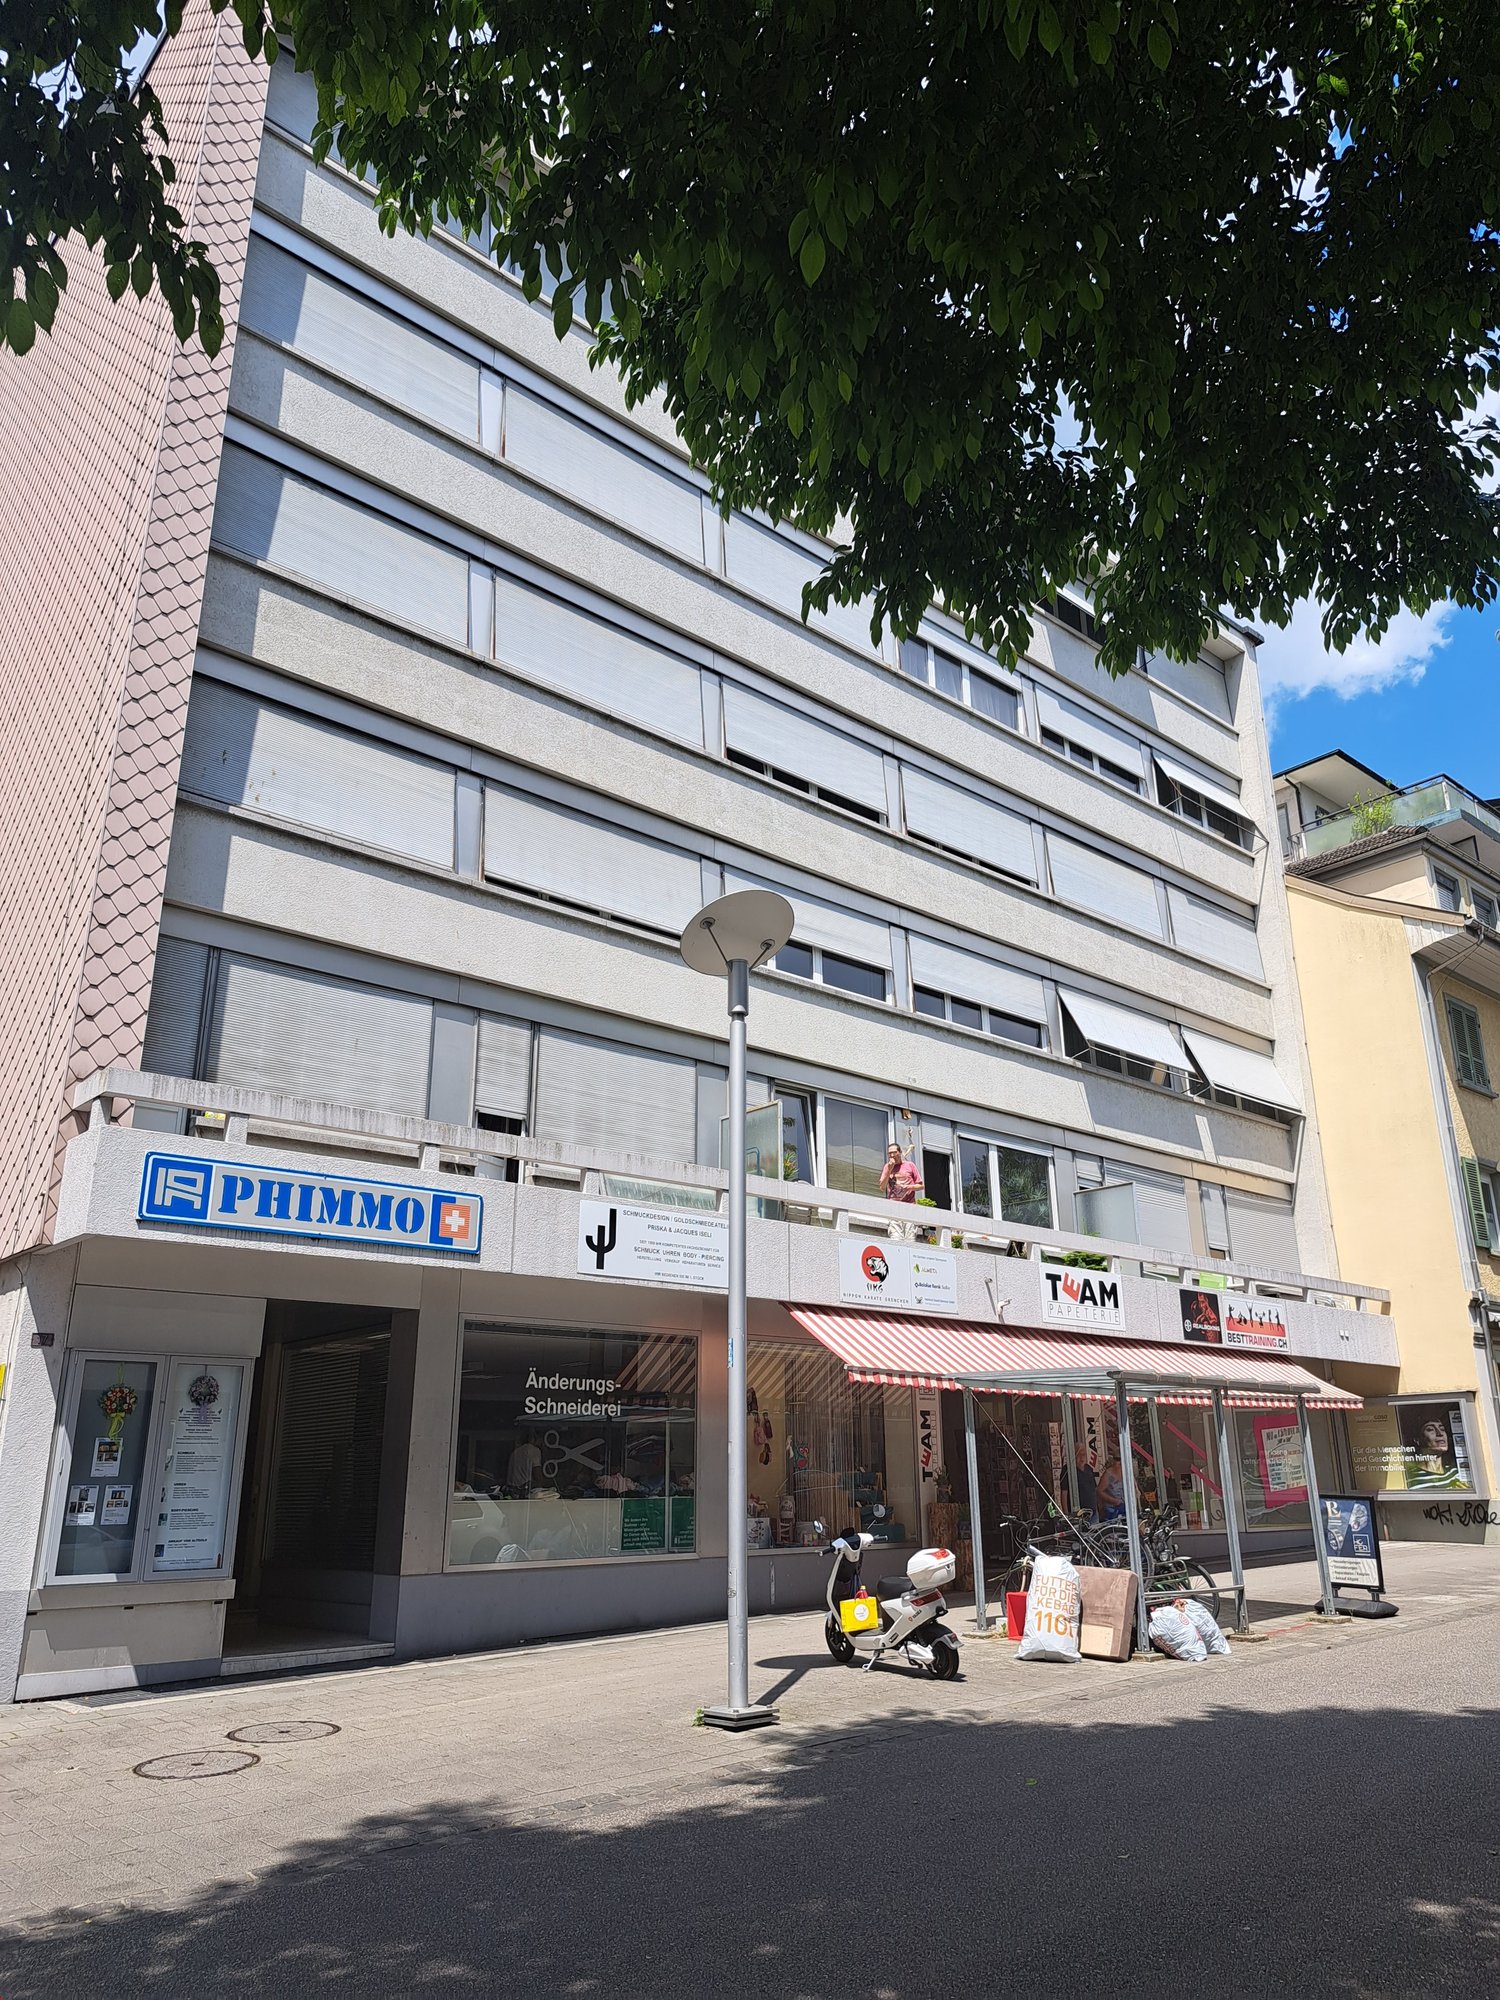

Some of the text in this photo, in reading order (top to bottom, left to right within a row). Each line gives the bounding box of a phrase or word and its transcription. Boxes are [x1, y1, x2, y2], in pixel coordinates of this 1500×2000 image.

[218, 1174, 425, 1234] PHIMMO
[623, 1210, 670, 1221] SCHMUCKDESIGN
[647, 1224, 668, 1232] PRISKA
[673, 1228, 698, 1236] JACQUES
[634, 1246, 660, 1255] SCHMUCK
[662, 1249, 680, 1257] UHREN
[701, 1254, 724, 1262] PIERCING
[1045, 1271, 1119, 1309] TEAM
[1049, 1303, 1119, 1323] PAPETERIE
[1193, 1323, 1220, 1332] REALBOXING
[1227, 1332, 1288, 1349] BESTTRAINING.CH
[525, 1367, 622, 1396] Änderungs-
[524, 1396, 622, 1417] Schneiderei
[920, 1410, 933, 1482] TEAM
[1368, 1455, 1414, 1463] Geschichten
[1415, 1454, 1438, 1462] hinter
[1369, 1464, 1406, 1472] Immobilie.
[1036, 1575, 1077, 1593] FUTTER
[1034, 1585, 1077, 1604] FÜR DIE
[1036, 1596, 1075, 1615] KEBAG
